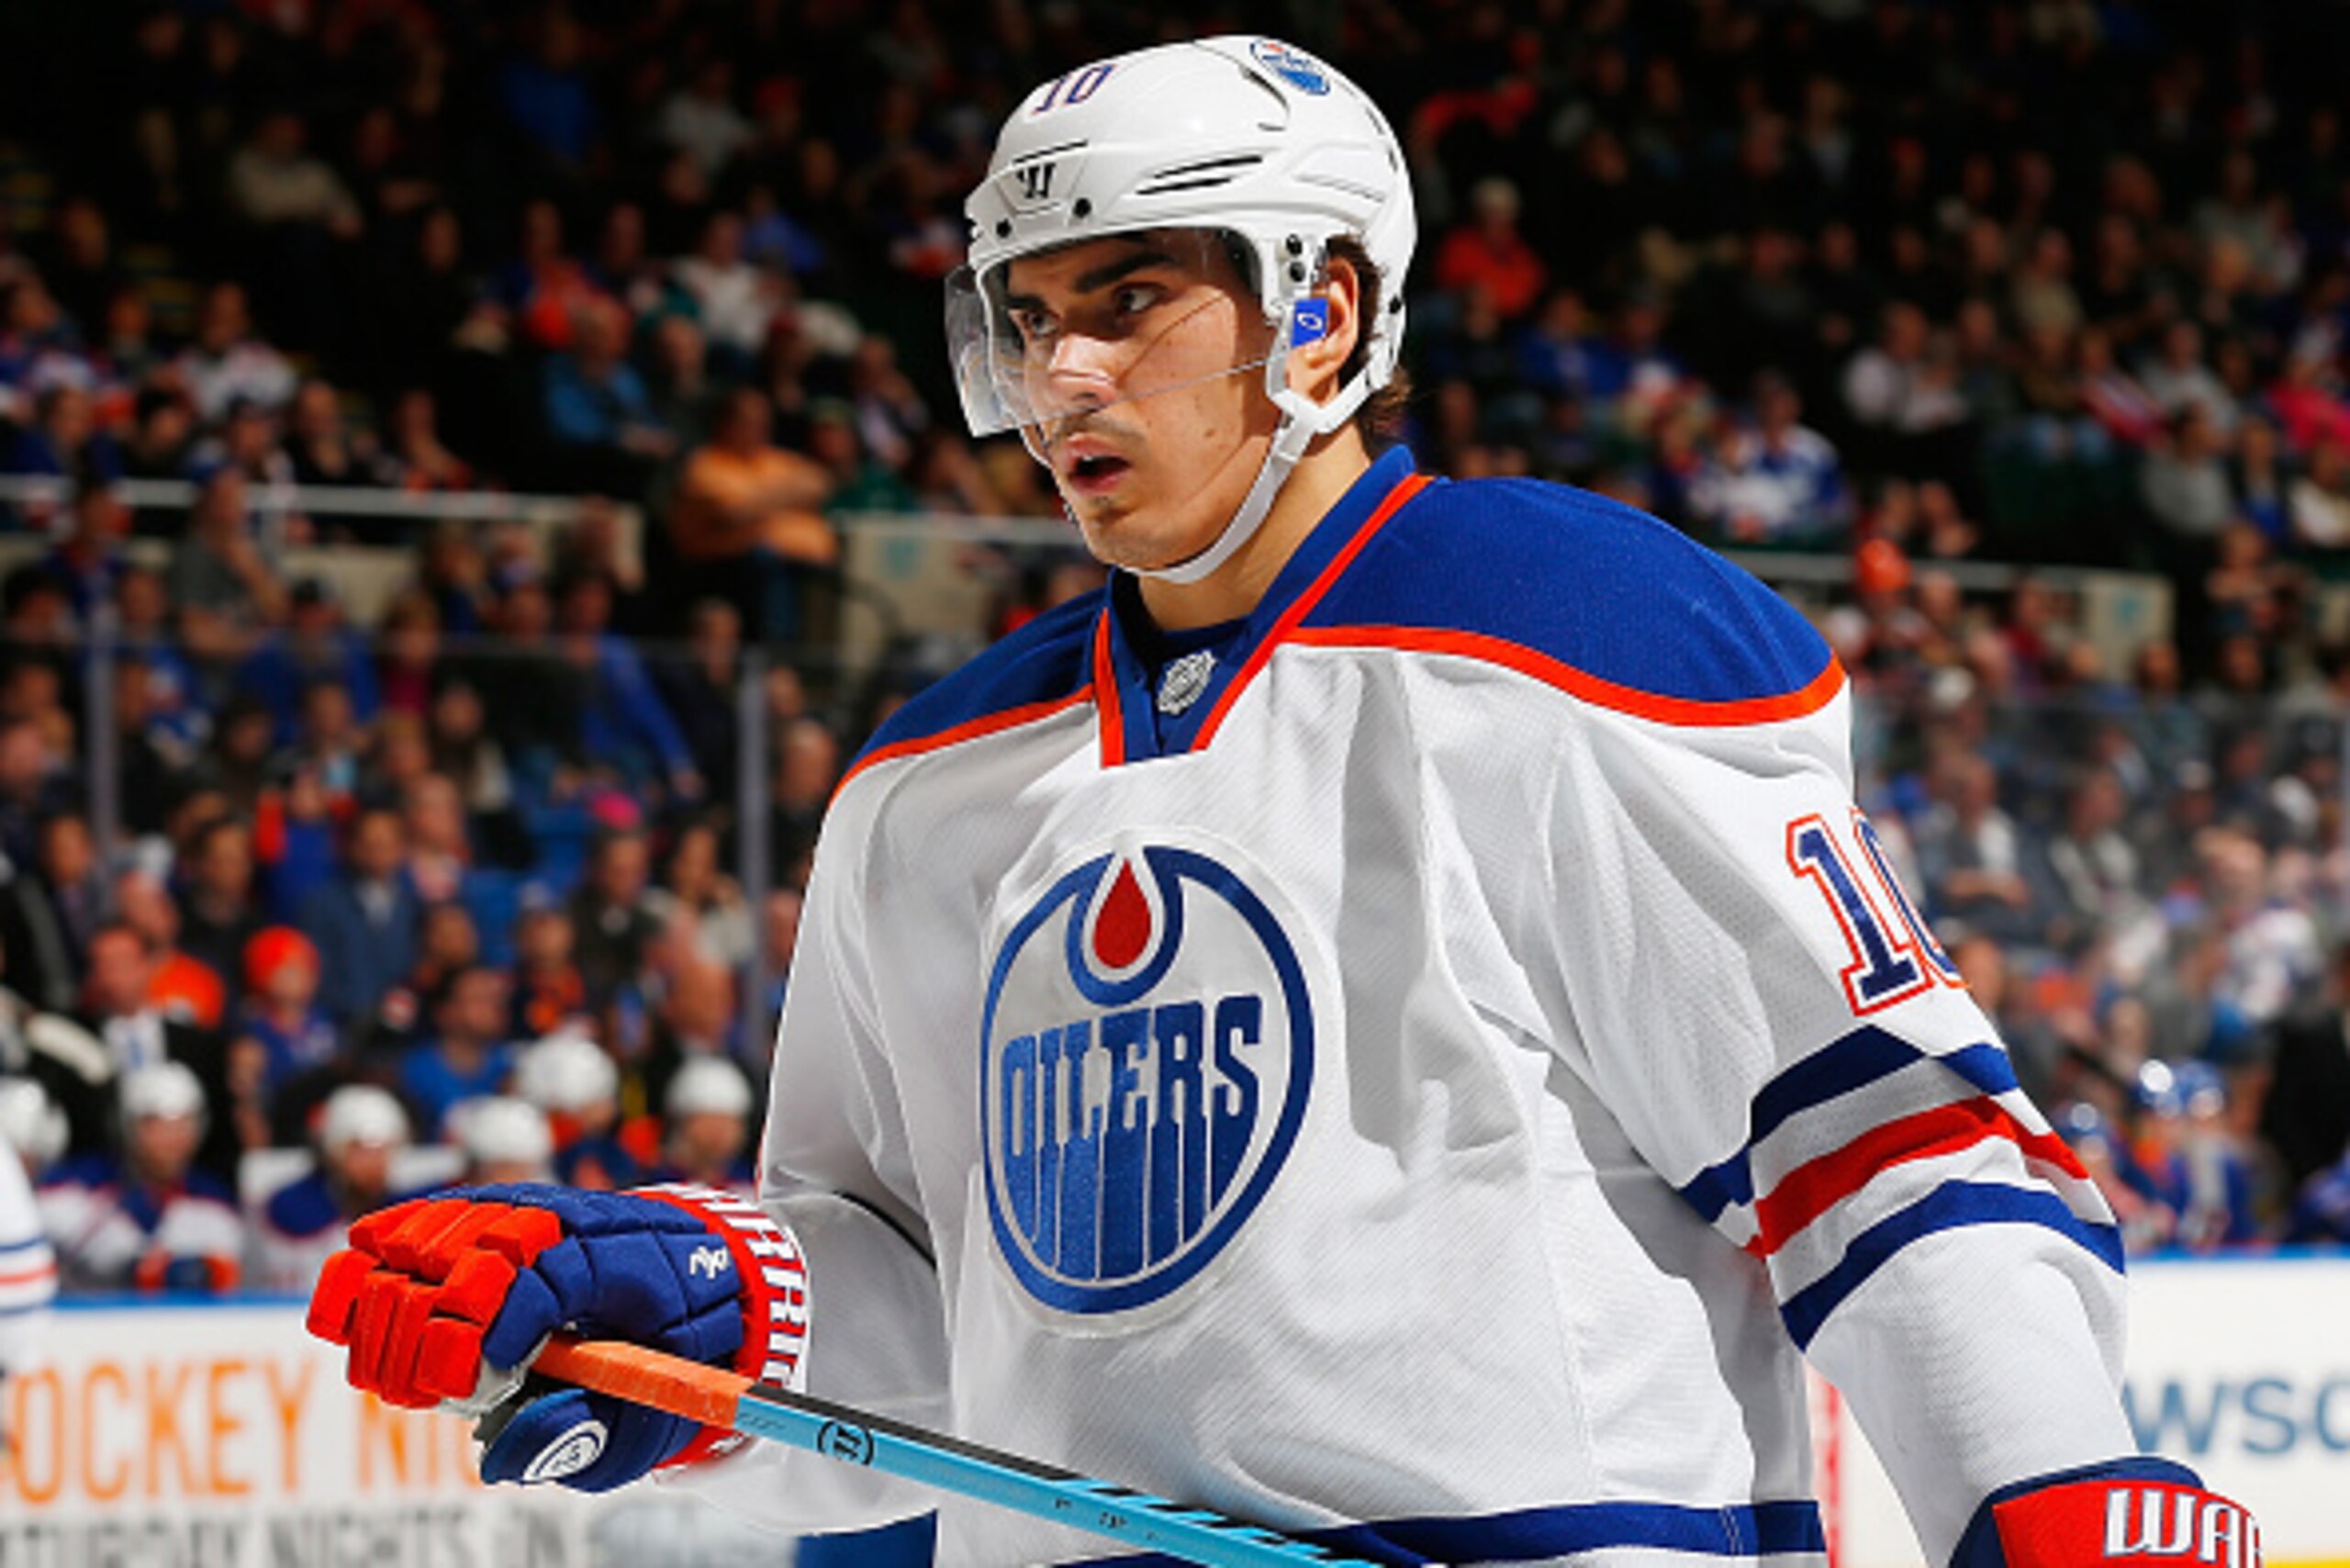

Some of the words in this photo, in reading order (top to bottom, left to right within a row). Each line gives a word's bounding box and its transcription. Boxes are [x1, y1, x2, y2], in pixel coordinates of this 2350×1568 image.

[1030, 63, 1117, 116] 10
[1001, 994, 1262, 1282] OILERS
[0, 1359, 312, 1504] OCKEY
